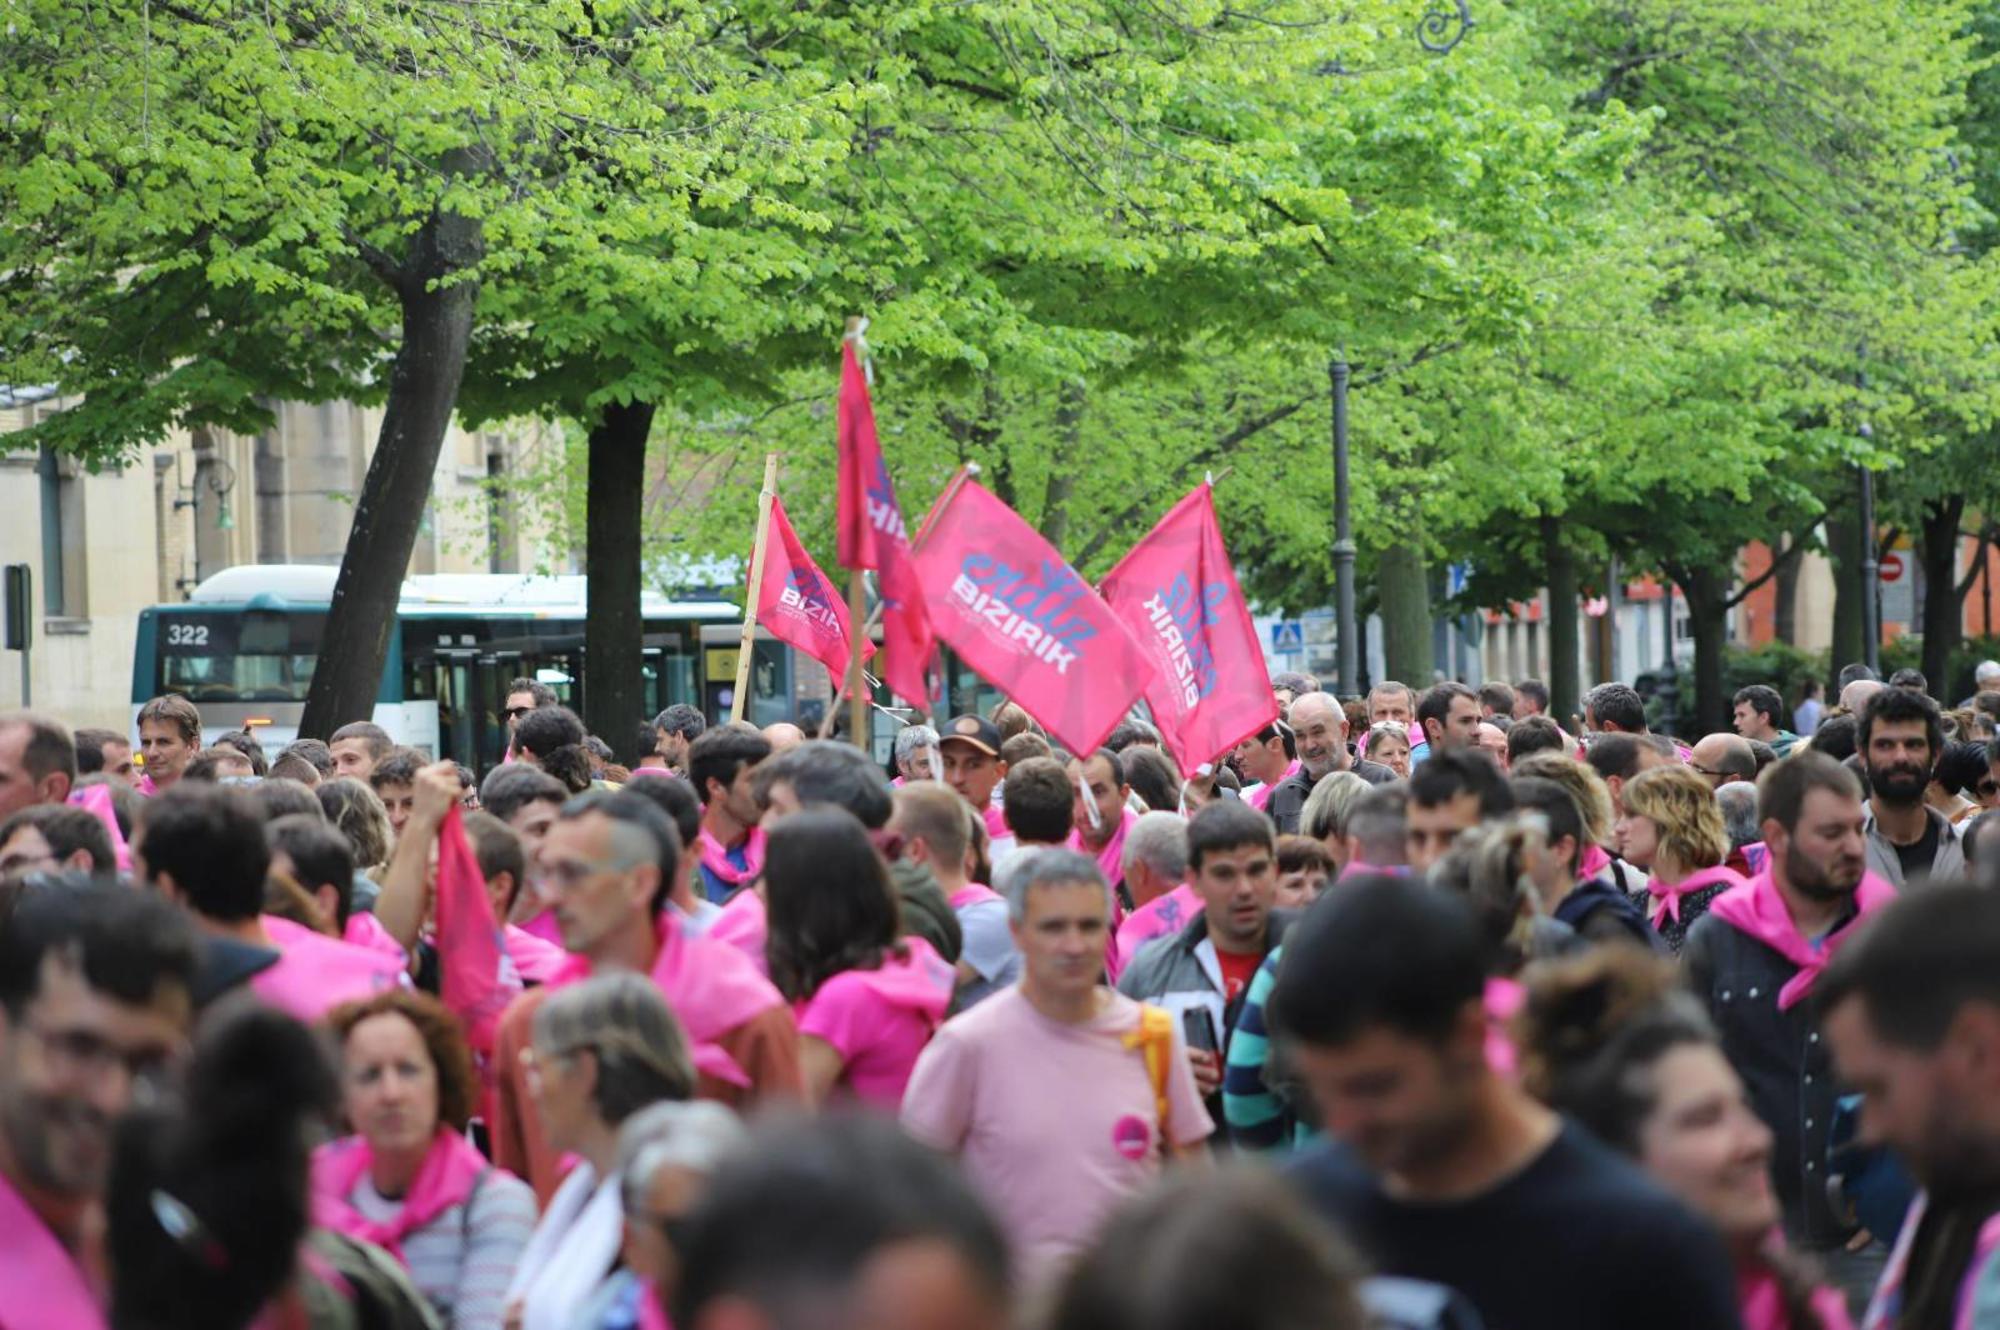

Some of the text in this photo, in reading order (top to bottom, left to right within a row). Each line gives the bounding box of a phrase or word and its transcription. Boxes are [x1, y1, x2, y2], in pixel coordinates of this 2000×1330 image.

[780, 586, 841, 634] BIZIR
[951, 573, 1076, 675] BIZIRIK
[167, 624, 209, 646] 322
